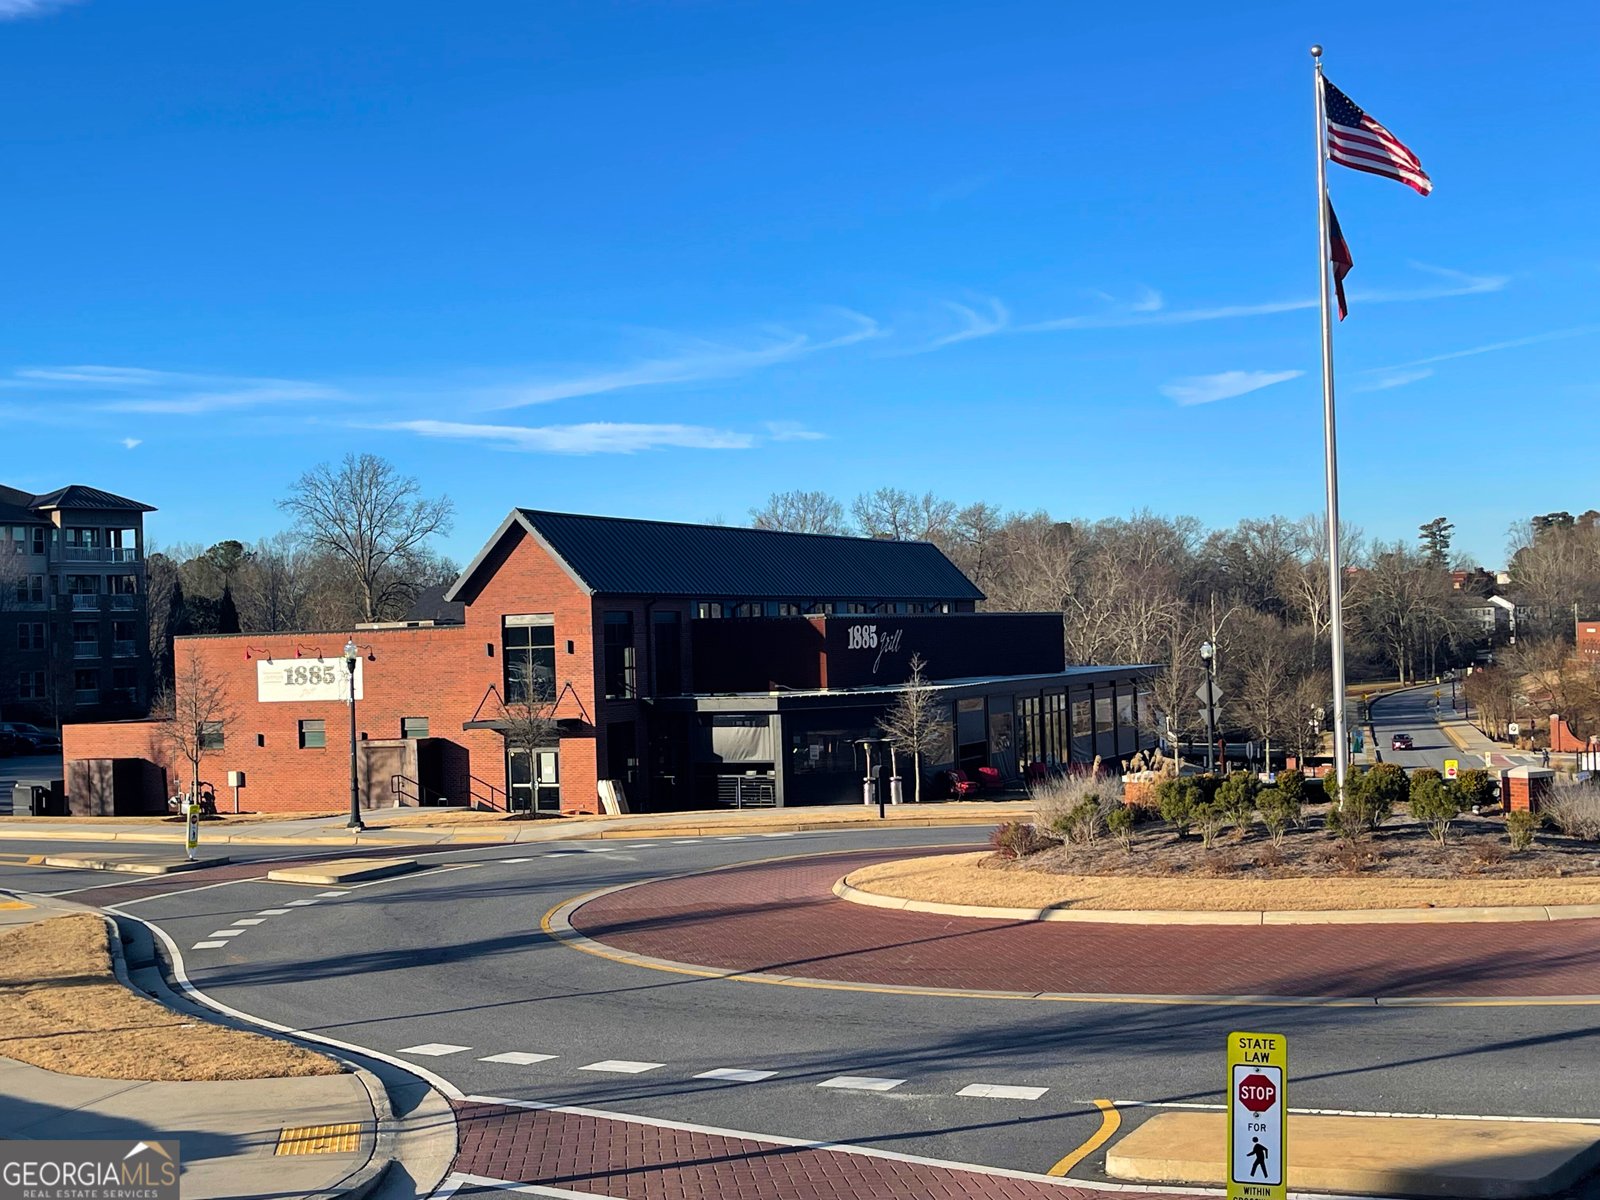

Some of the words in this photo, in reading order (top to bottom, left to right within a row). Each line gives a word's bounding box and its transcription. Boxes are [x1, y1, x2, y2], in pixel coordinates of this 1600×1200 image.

[848, 625, 878, 649] 1885
[284, 665, 336, 686] 1885
[1239, 1038, 1276, 1050] STATE
[1244, 1052, 1270, 1063] LAW
[1241, 1085, 1274, 1101] STOP
[1247, 1122, 1267, 1132] FOR
[1243, 1186, 1271, 1197] WITHIN
